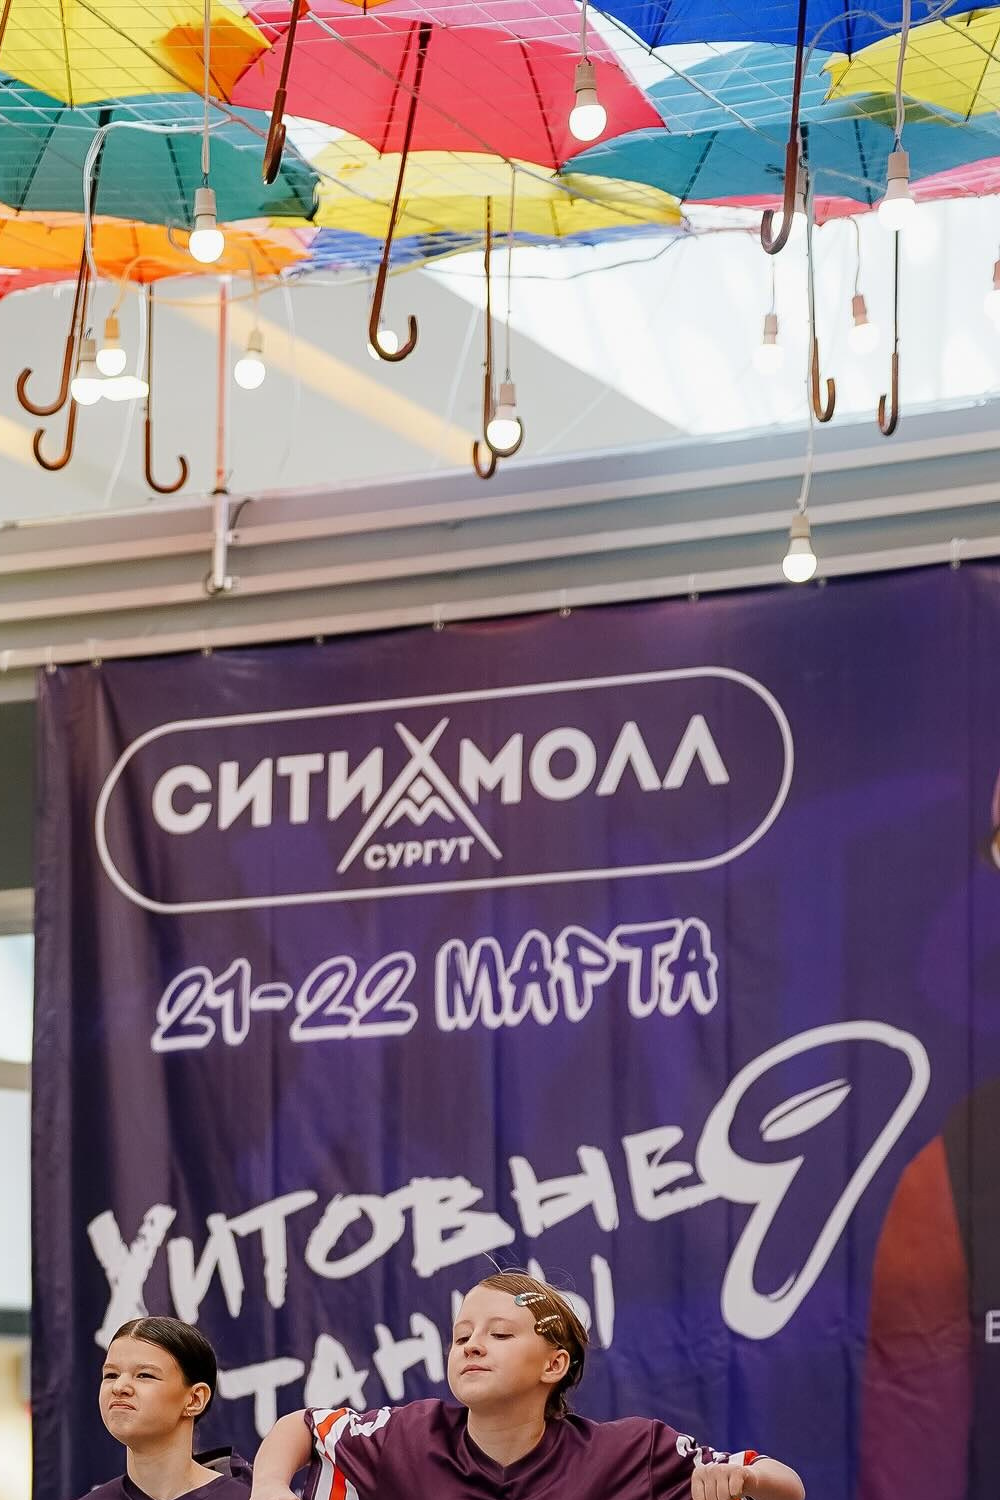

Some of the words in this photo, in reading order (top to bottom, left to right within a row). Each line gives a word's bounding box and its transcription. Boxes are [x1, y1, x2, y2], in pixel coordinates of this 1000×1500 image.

[152, 747, 384, 834] СИТИ
[459, 713, 730, 805] МОЛЛ
[363, 836, 475, 872] СУРГУТ
[150, 951, 418, 1053] 21-22
[435, 917, 718, 1031] МАРТА
[86, 1125, 718, 1350] ХИТОВЫЕ
